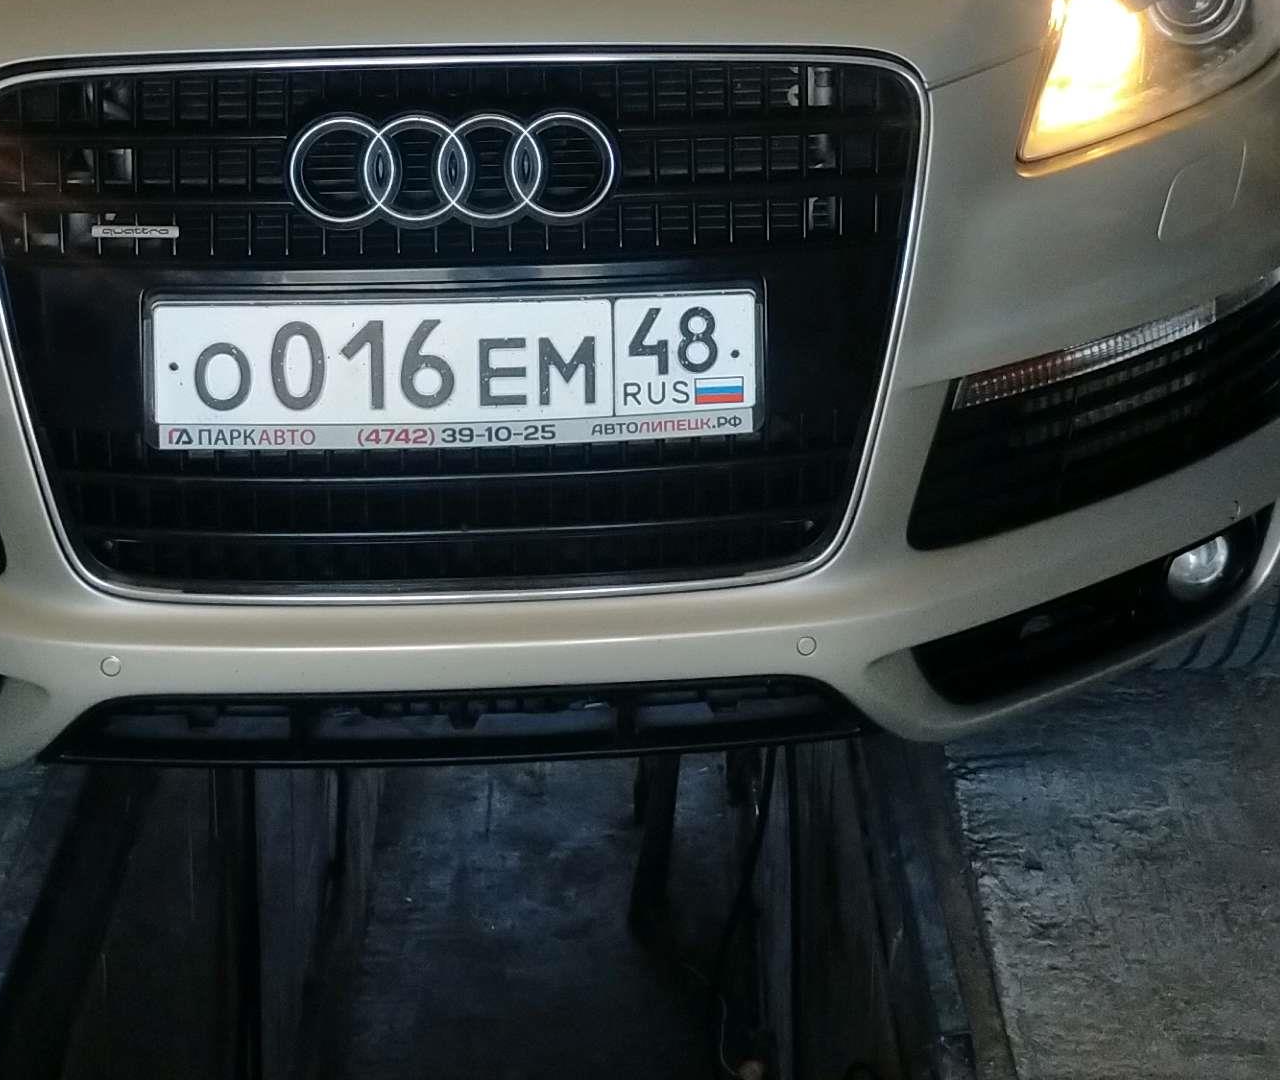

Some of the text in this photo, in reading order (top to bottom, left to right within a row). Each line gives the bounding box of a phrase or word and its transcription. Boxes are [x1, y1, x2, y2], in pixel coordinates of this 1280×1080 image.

[102, 228, 169, 236] quattro
[628, 306, 718, 375] 48
[622, 381, 690, 405] RUS
[198, 416, 743, 446] ПАРКАВТО (4742) 39-10-25 АВТОЛИПЕЦК.РФ
